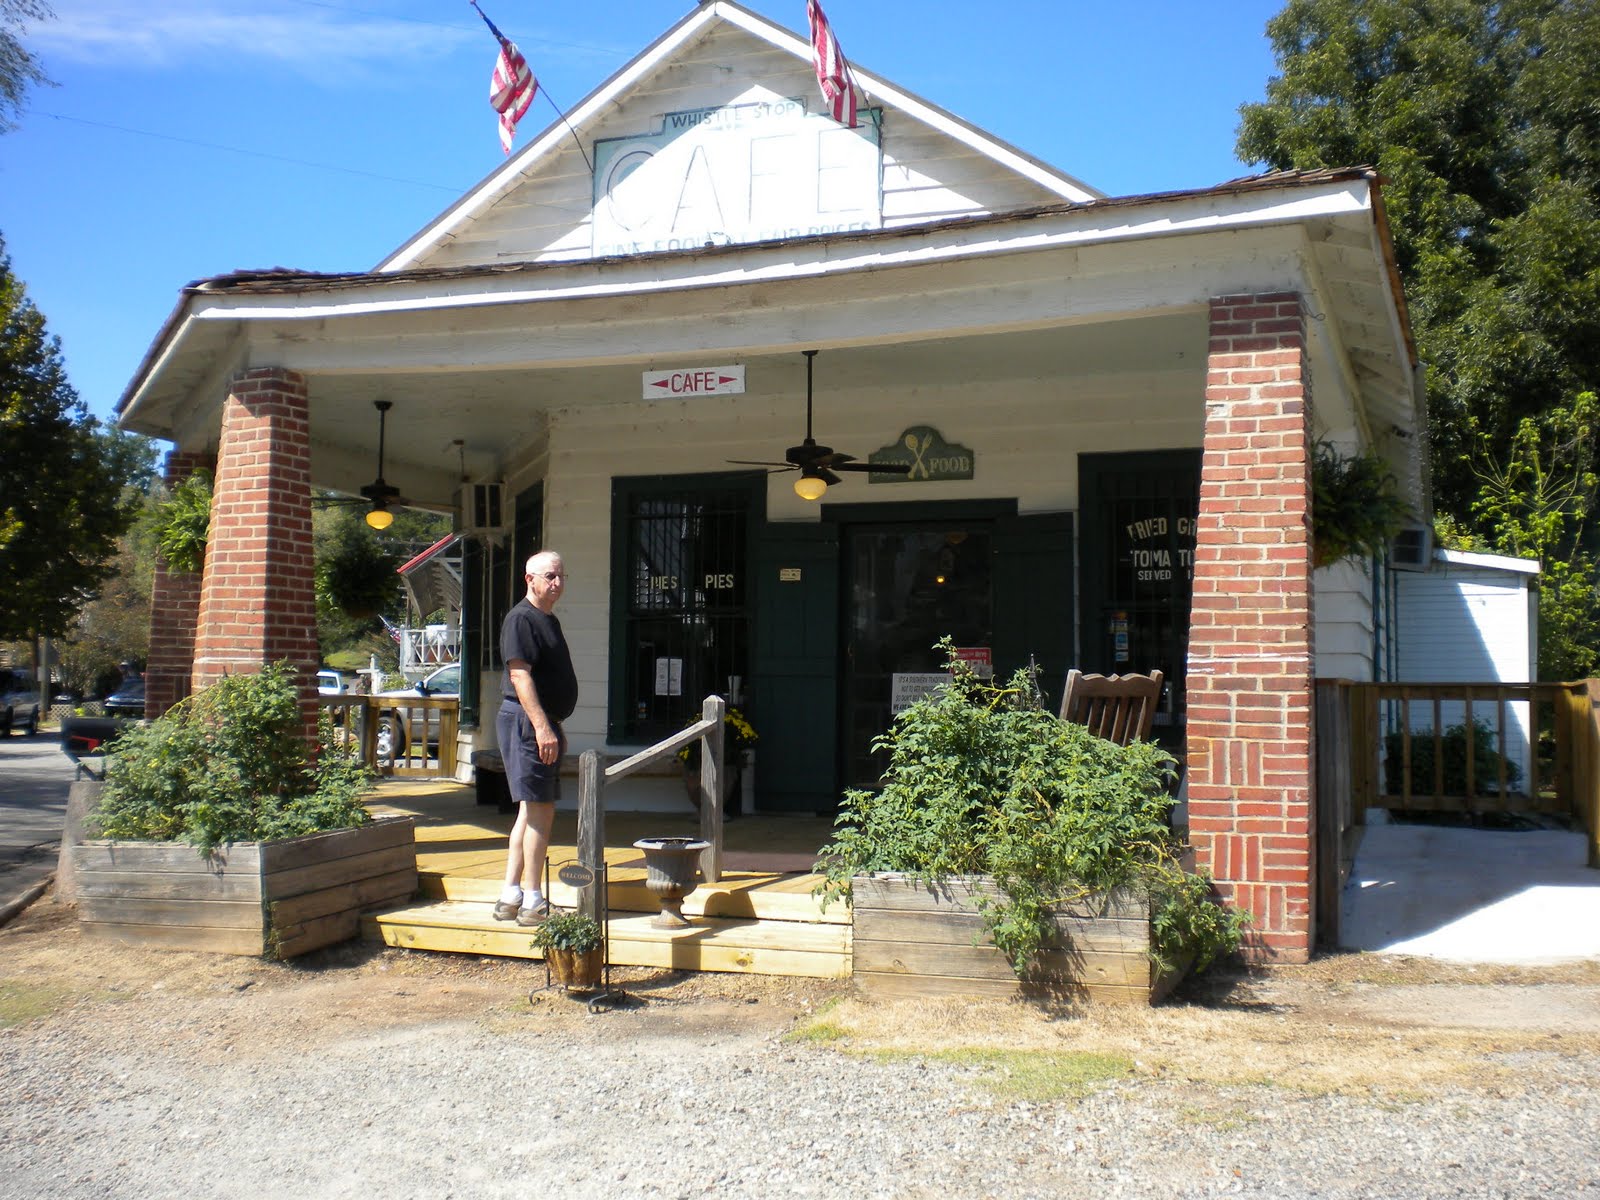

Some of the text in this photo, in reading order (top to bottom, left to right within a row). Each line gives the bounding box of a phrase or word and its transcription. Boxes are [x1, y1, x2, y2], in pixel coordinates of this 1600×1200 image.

[671, 102, 796, 128] WHISTLE STOP
[604, 126, 868, 233] CAFE
[671, 372, 716, 392] CAFE
[929, 456, 971, 473] FOOD
[1126, 517, 1168, 541] FRIED
[705, 573, 734, 589] PIES
[1137, 569, 1172, 581] SERVED
[561, 872, 592, 880] WELCOME
